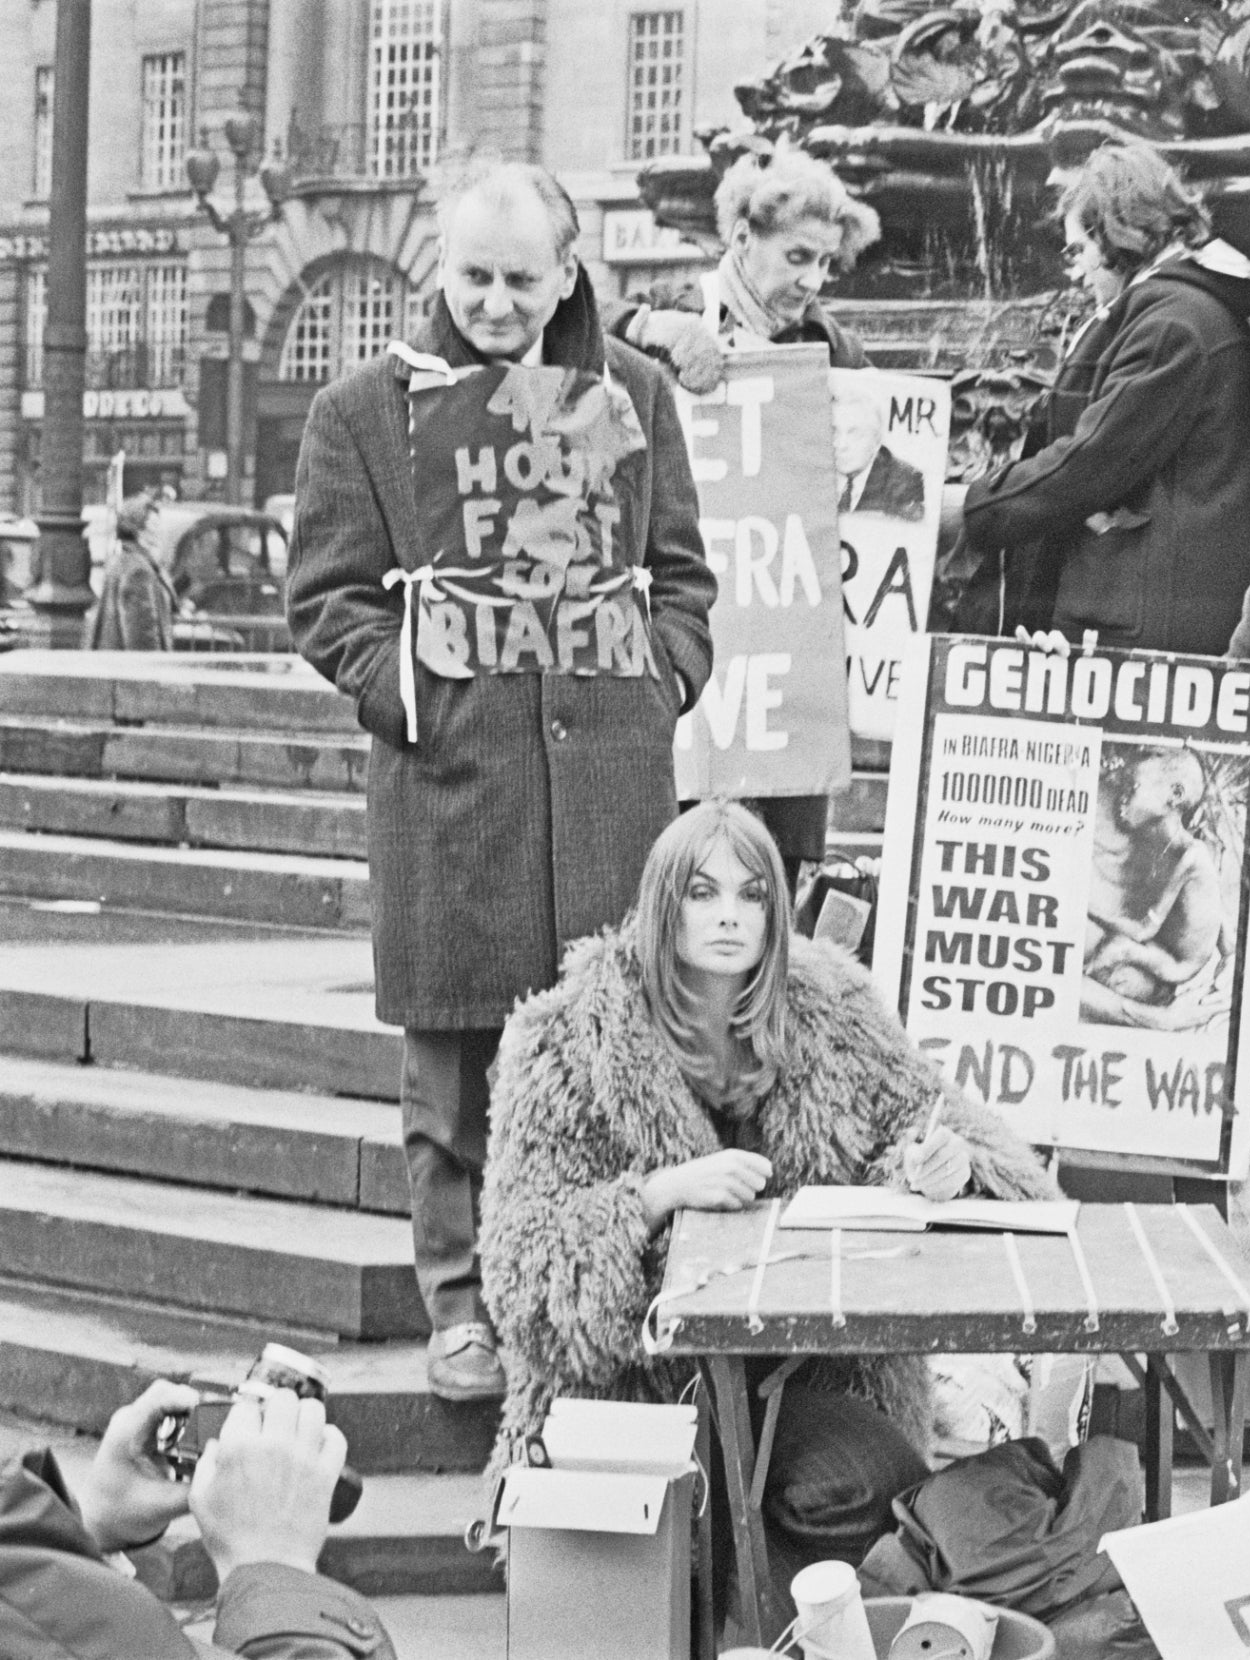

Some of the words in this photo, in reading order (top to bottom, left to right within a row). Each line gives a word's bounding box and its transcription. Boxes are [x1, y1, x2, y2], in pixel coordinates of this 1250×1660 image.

[888, 395, 938, 437] MR
[943, 738, 957, 755] IN
[942, 771, 1043, 809] 1000000
[1046, 788, 1089, 814] DEAD
[938, 810, 972, 822] How
[979, 816, 1024, 832] many
[1030, 820, 1085, 837] more?
[935, 840, 1052, 882] THIS
[931, 885, 1060, 929] WAR
[924, 930, 1075, 975] MUST
[920, 976, 1056, 1018] STOP
[1051, 1044, 1127, 1109] THE
[1145, 1056, 1239, 1117] WAR
